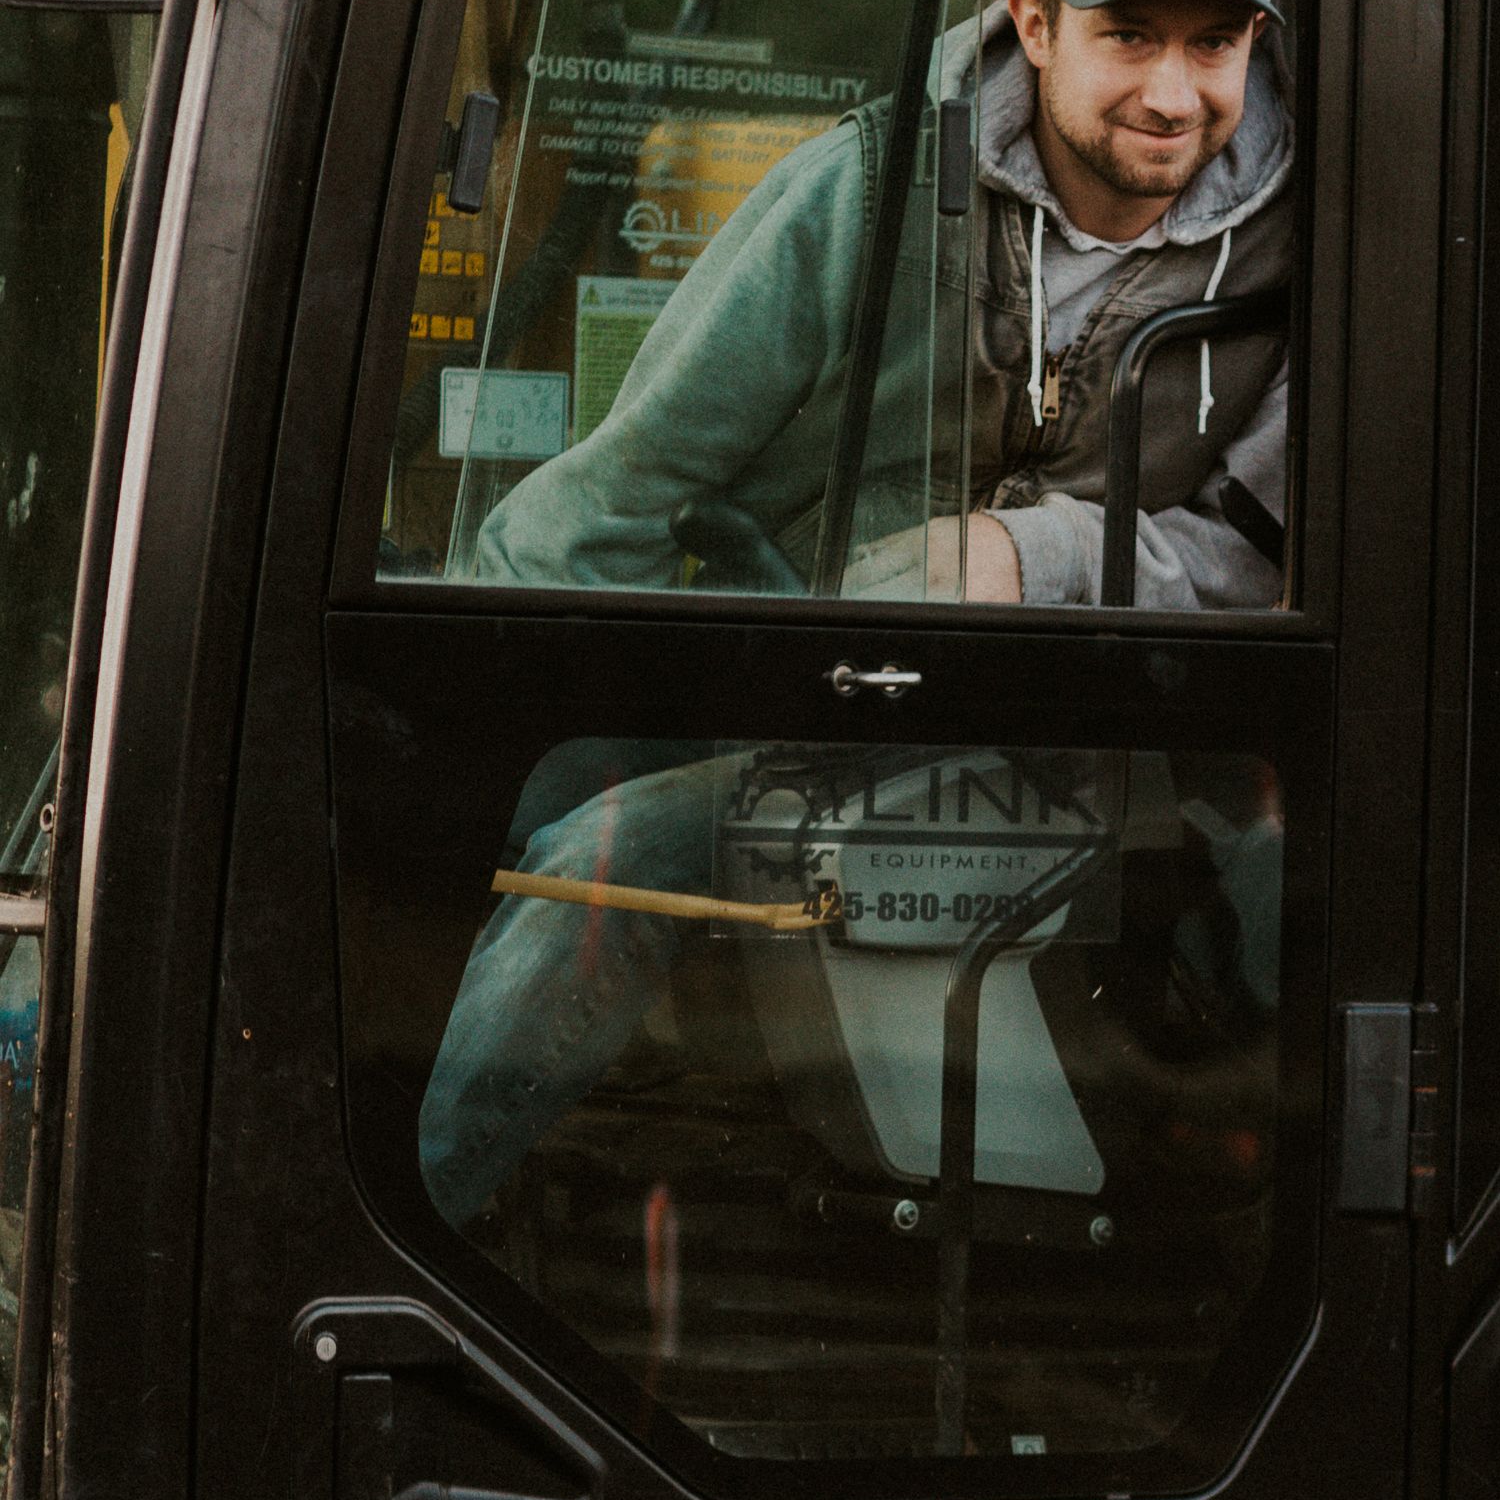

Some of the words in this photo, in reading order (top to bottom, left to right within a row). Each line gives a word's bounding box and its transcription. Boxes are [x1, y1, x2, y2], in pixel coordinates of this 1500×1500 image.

[527, 54, 664, 85] CUSTOMER
[672, 63, 866, 102] RESPONSIBILITY
[539, 134, 596, 153] DAMAGE
[863, 765, 1101, 825] LINK
